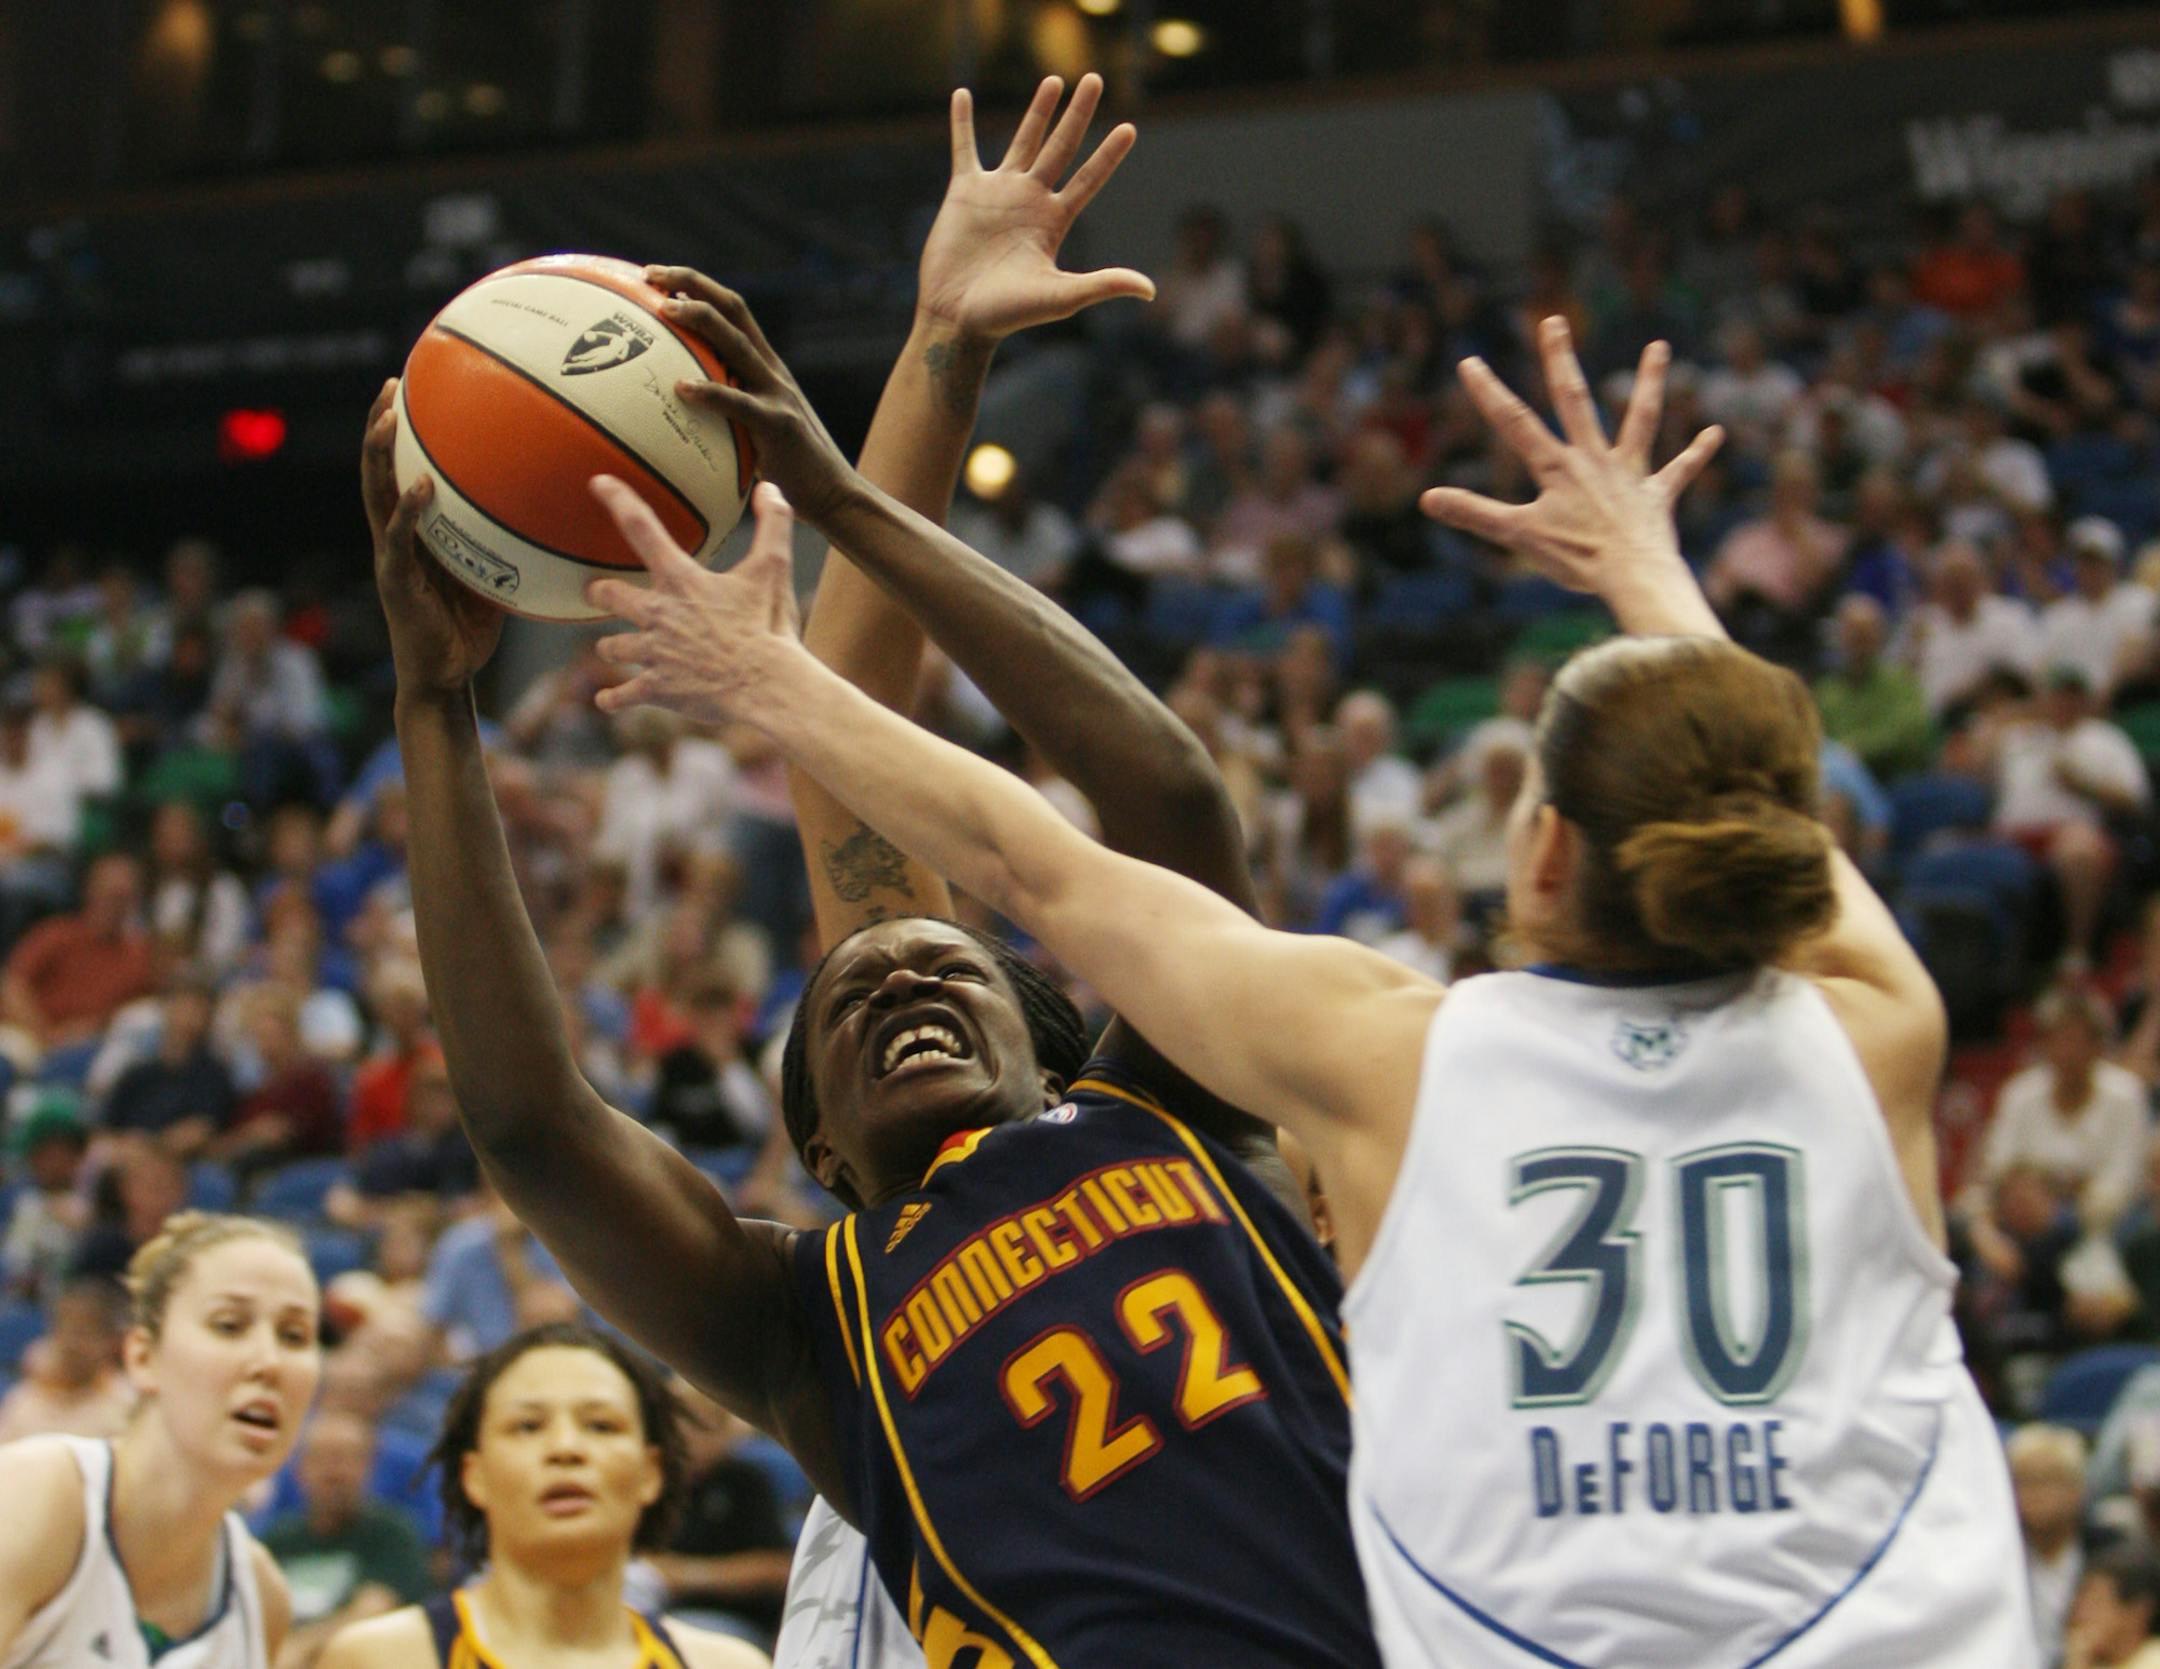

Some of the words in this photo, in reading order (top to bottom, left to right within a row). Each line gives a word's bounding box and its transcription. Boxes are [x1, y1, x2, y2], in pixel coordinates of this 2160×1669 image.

[611, 311, 655, 347] WNBA
[880, 1156, 1230, 1402] CONNECTICUT
[998, 1267, 1269, 1505] 22
[1504, 1141, 1810, 1409] 30
